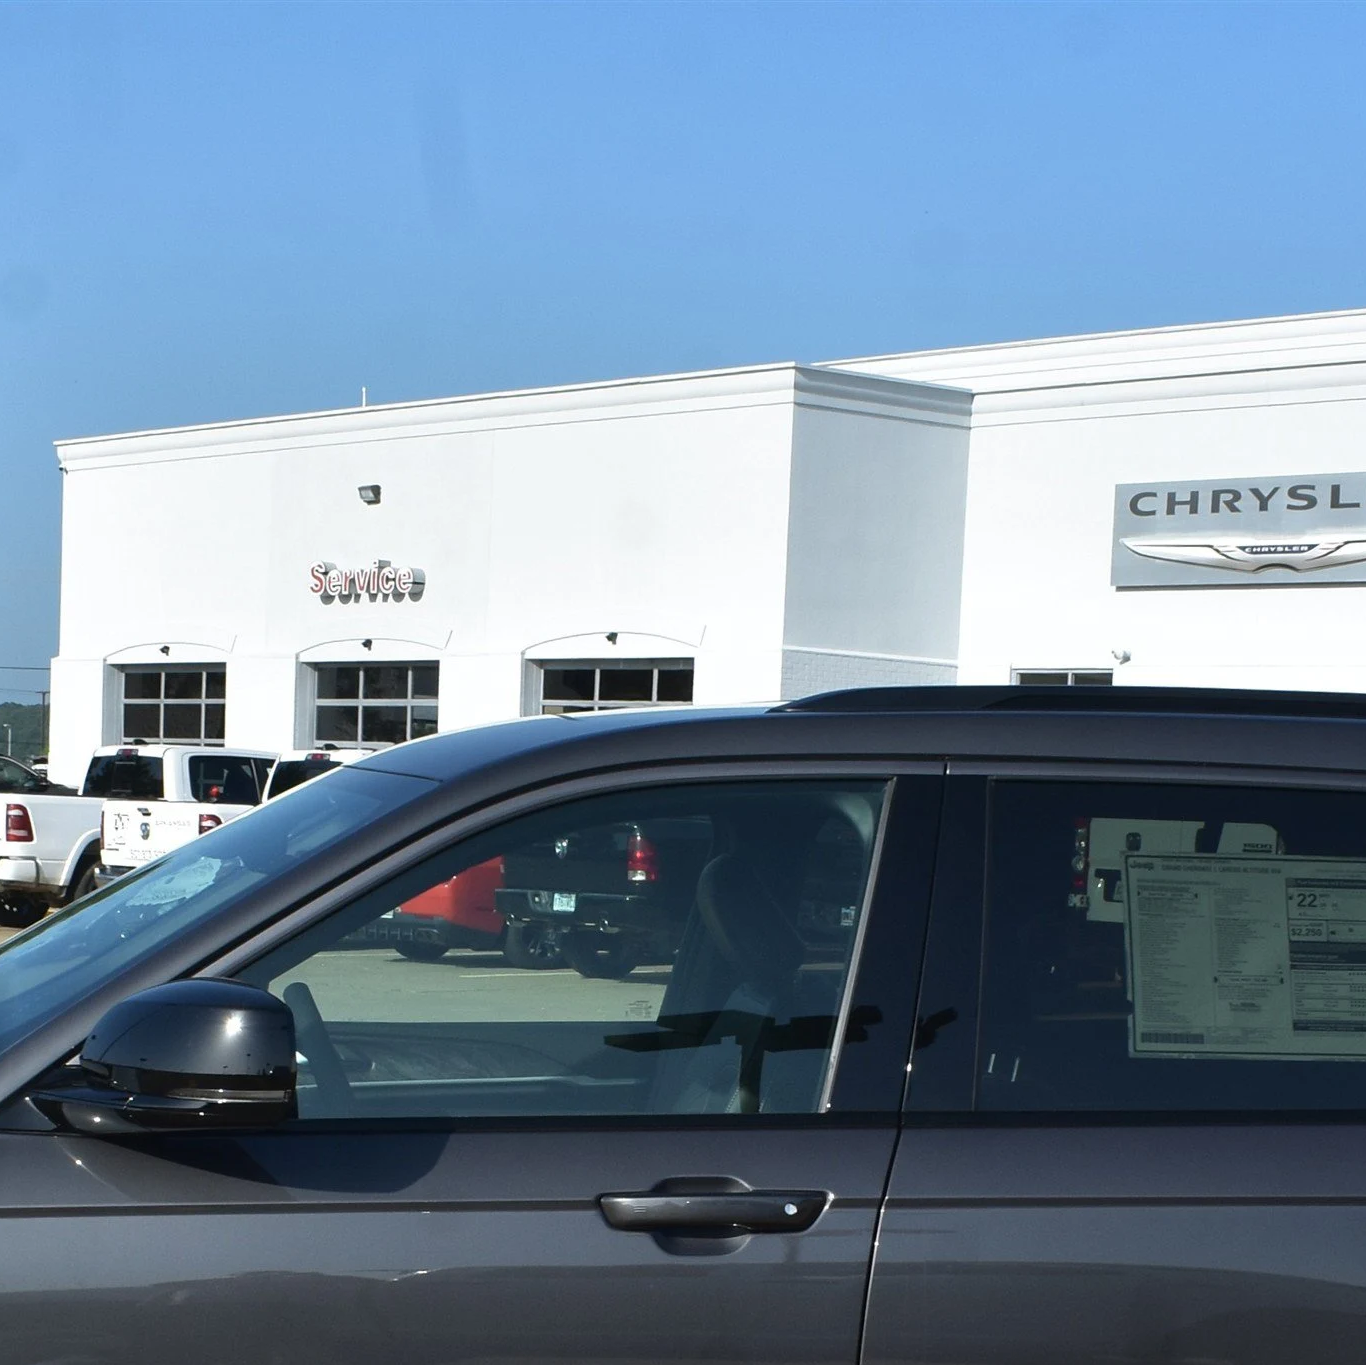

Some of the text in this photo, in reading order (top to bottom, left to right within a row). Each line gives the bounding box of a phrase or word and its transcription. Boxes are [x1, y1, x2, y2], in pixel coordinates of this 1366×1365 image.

[1244, 545, 1309, 553] CHRYSLER
[310, 559, 414, 597] Service
[1296, 892, 1318, 908] 22
